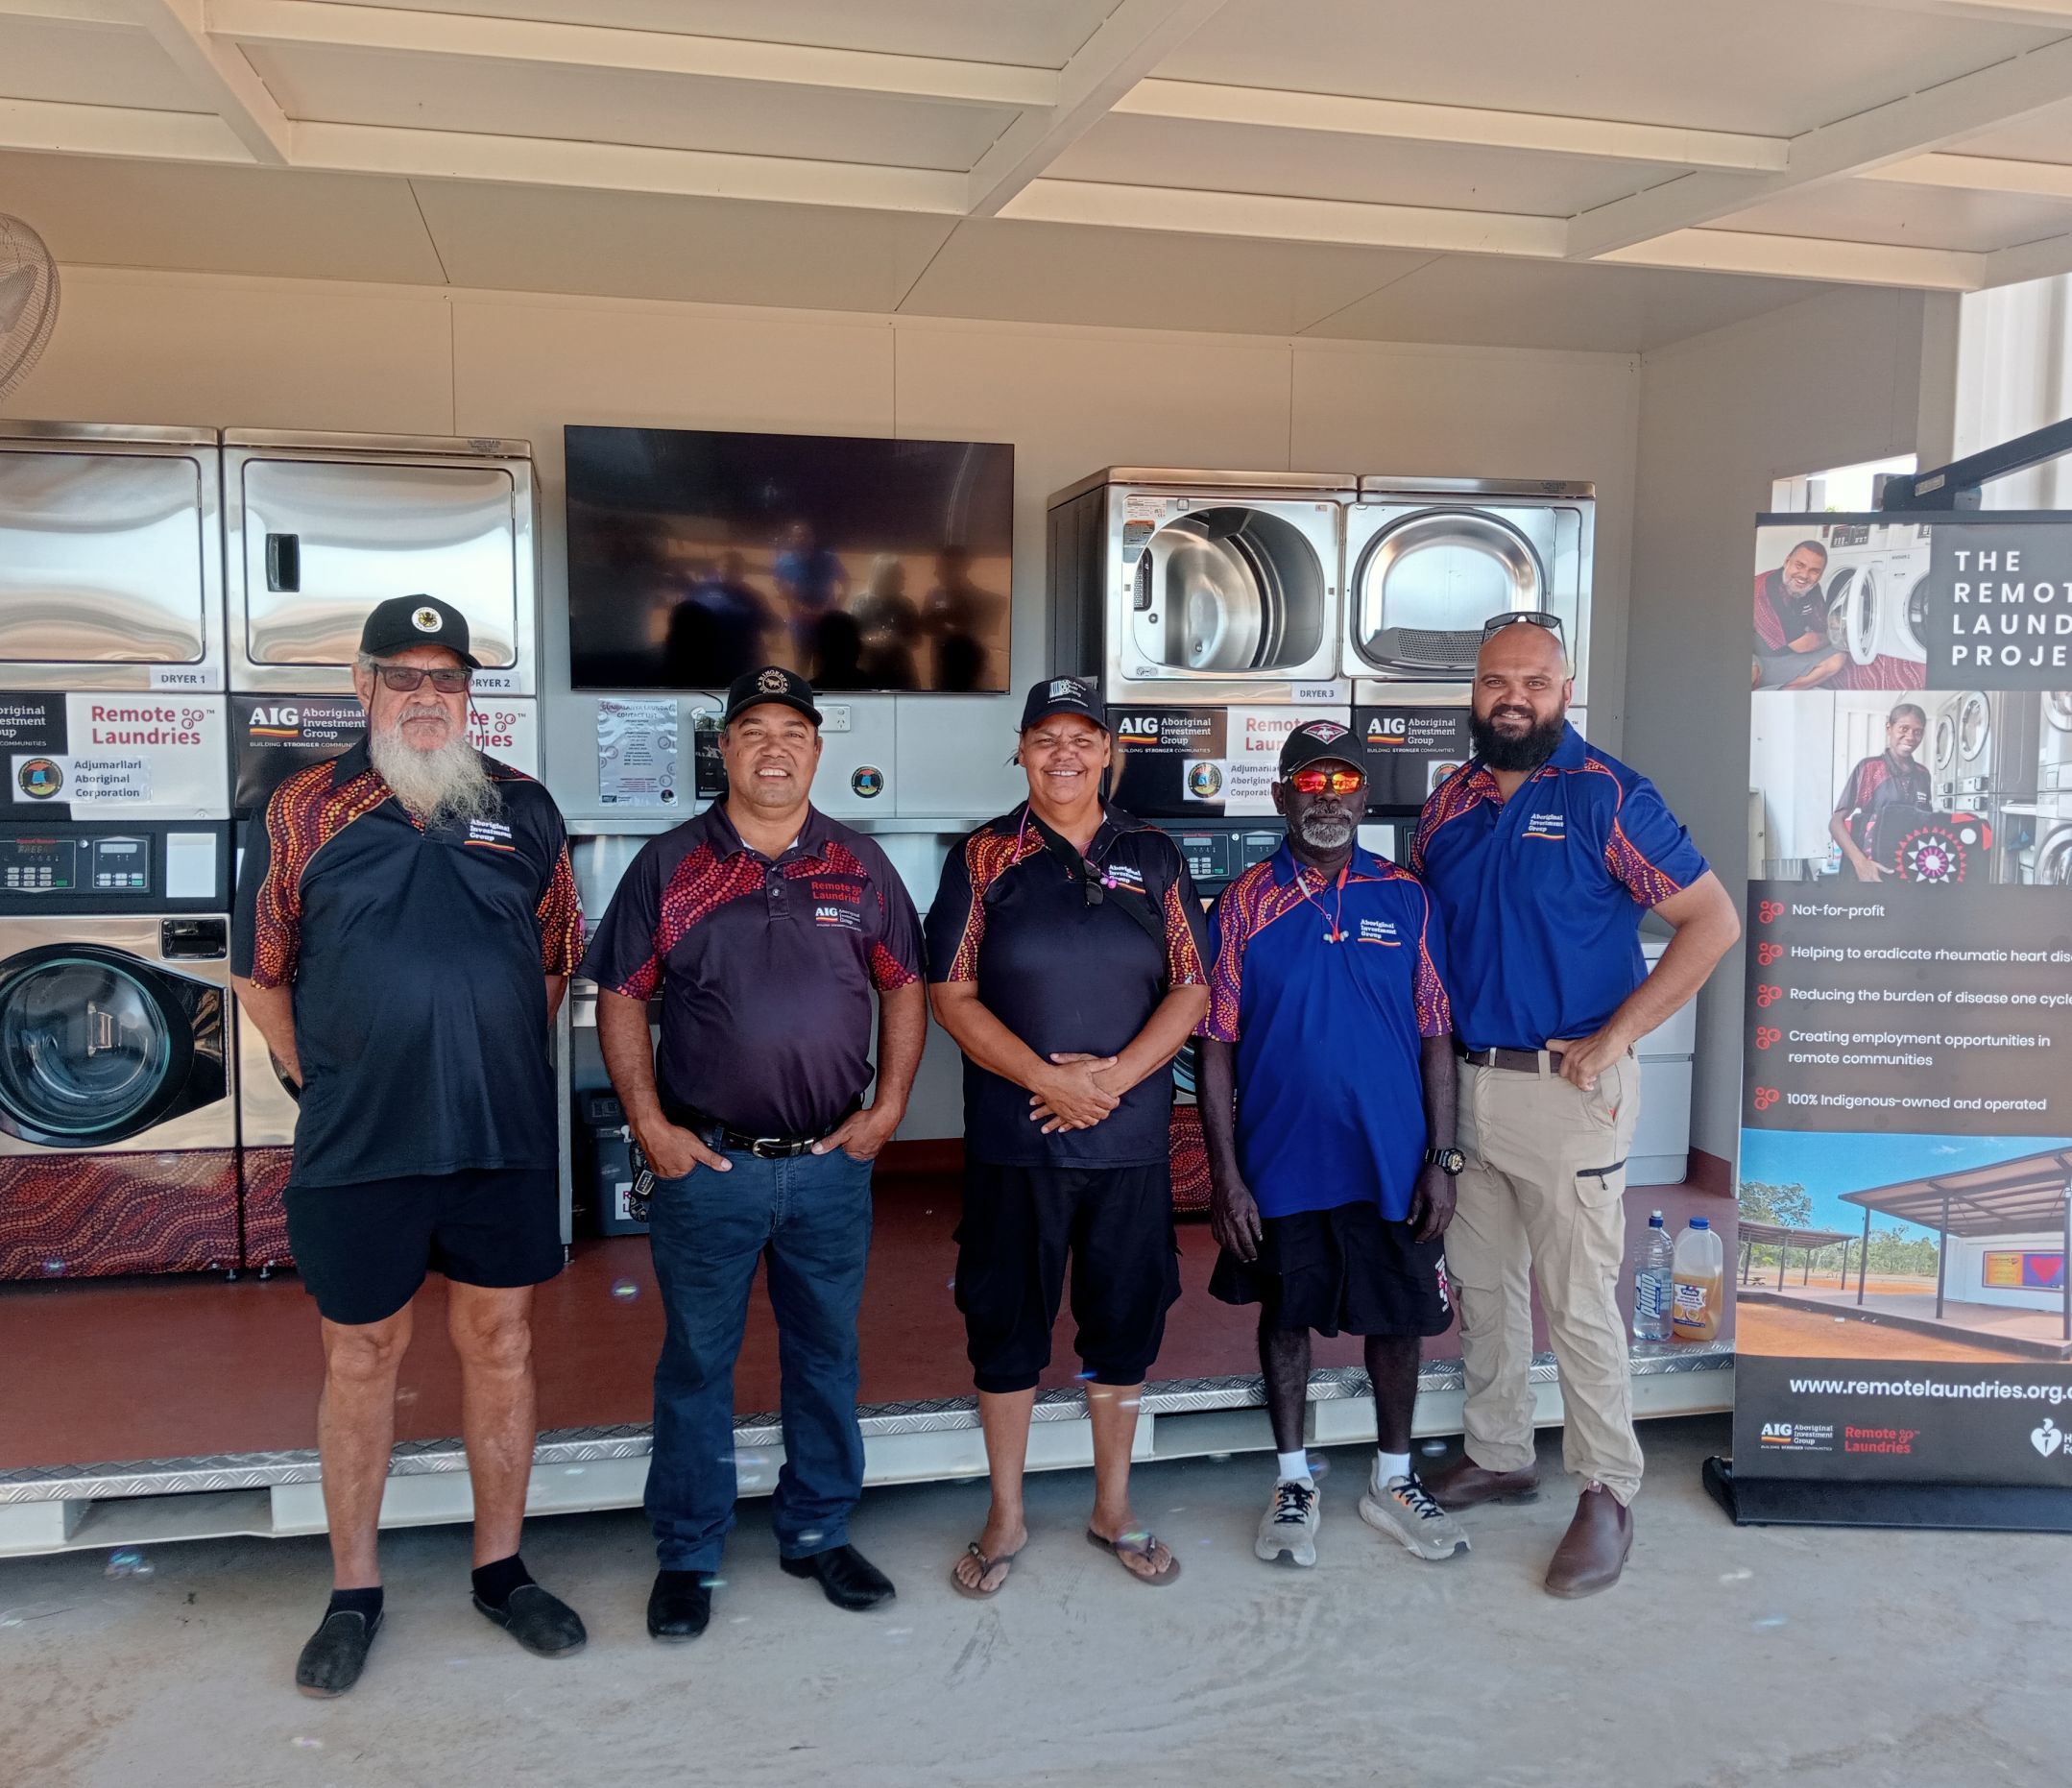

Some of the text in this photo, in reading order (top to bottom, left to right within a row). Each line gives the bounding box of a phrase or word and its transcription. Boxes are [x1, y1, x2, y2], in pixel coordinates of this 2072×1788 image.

[1954, 550, 2020, 571] THE
[1954, 582, 2072, 603] REMOT
[1952, 614, 2072, 635] LAUND
[1952, 645, 2067, 666] PROJE
[161, 674, 205, 684] DRYER 1
[504, 679, 511, 688] 2
[1299, 689, 1335, 698] DRYER 3
[91, 706, 176, 722] Remote
[249, 707, 300, 726] AIG
[302, 708, 365, 719] Aboriginal
[0, 716, 46, 726] estment
[302, 718, 366, 728] Investment
[1119, 717, 1159, 734] AIG
[1161, 717, 1212, 728] Aboriginal
[1246, 717, 1306, 732] Remot
[1367, 717, 1406, 734] AIG
[1408, 718, 1456, 728] Aboriginal
[92, 727, 201, 745] Laundries
[302, 729, 338, 739] Group
[1161, 727, 1211, 736] Investment
[1408, 727, 1456, 736] Investment
[1161, 737, 1189, 745] Group
[1408, 737, 1434, 745] Group
[75, 774, 130, 785] Aboriginal
[76, 787, 140, 799] Corporation
[1231, 788, 1271, 798] Corporati
[470, 818, 510, 832] Aboriginal
[470, 832, 494, 841] Group
[811, 882, 851, 892] Remote
[812, 891, 860, 904] Laundries
[815, 907, 838, 916] AIG
[1792, 904, 1885, 919] Not-for-profit
[1361, 918, 1395, 929] Aboriginal
[1361, 930, 1382, 939] Group
[1791, 946, 2072, 962] Helping to eradicate rheumatic heart dis
[1790, 988, 2072, 1008] Reducing the burden of disease one cycle
[1789, 1030, 2051, 1049] Creating employment opportunities in
[1788, 1053, 1933, 1066] remote communities
[1787, 1093, 2047, 1113] 100% Indigenous-owned and operated
[1761, 1423, 1793, 1437] AIG
[1794, 1424, 1833, 1433] Aboriginal
[1844, 1426, 1896, 1439] Remote
[1794, 1431, 1833, 1439] Investment
[1844, 1440, 1911, 1454] Laundries
